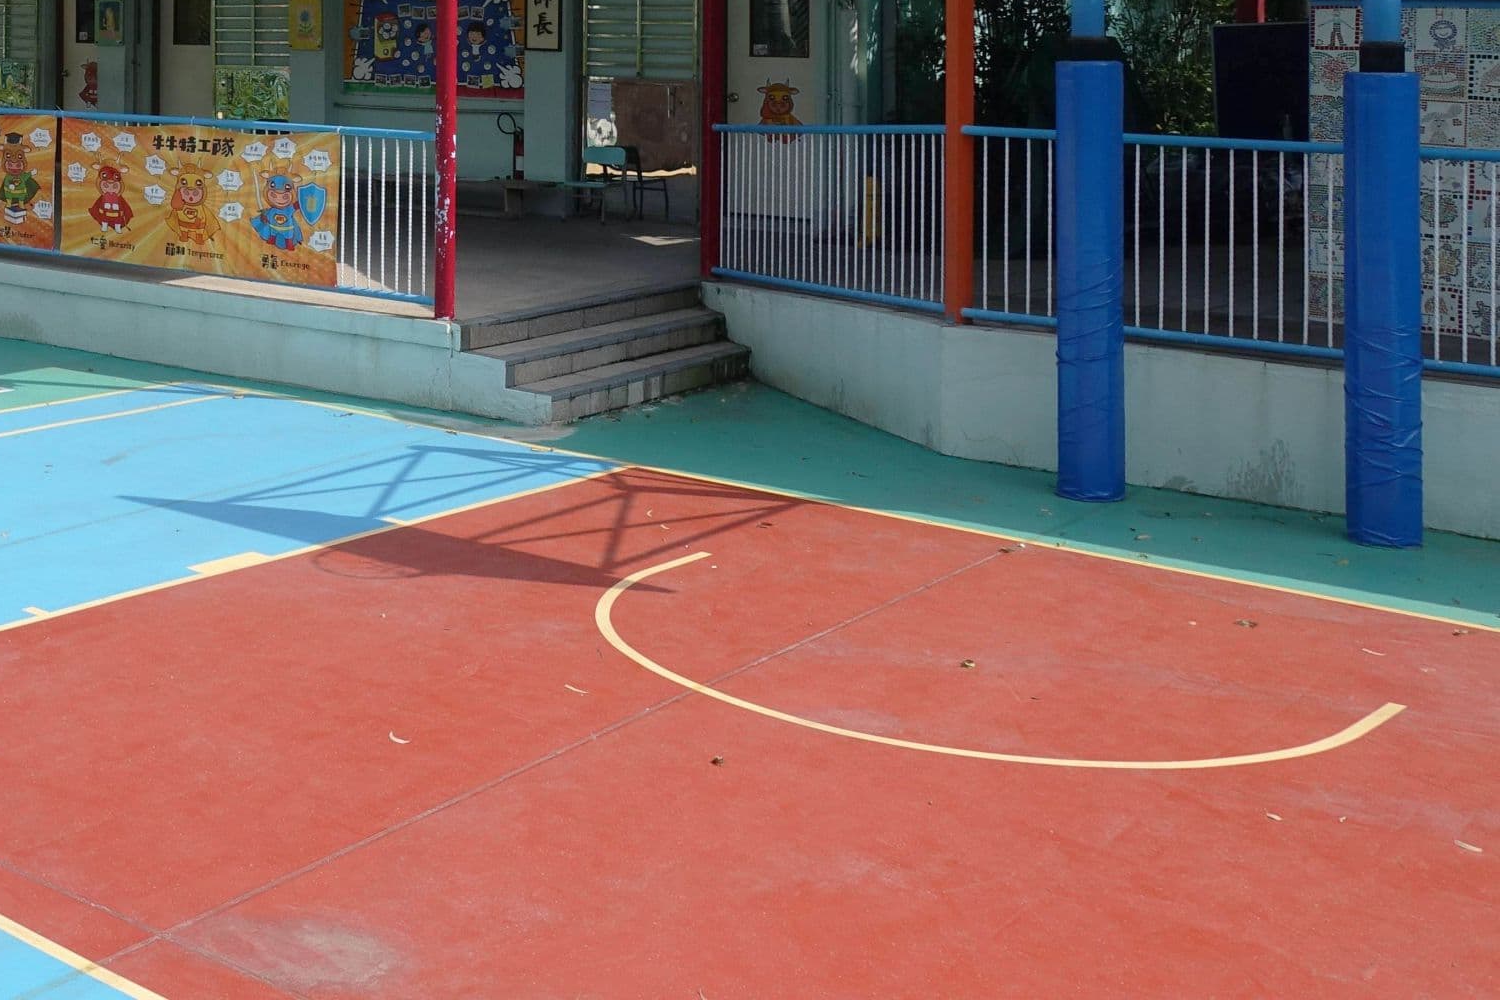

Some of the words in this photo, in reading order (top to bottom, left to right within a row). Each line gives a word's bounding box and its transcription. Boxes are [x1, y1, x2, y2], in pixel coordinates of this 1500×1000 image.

[152, 134, 235, 158] 牛牛特工隊
